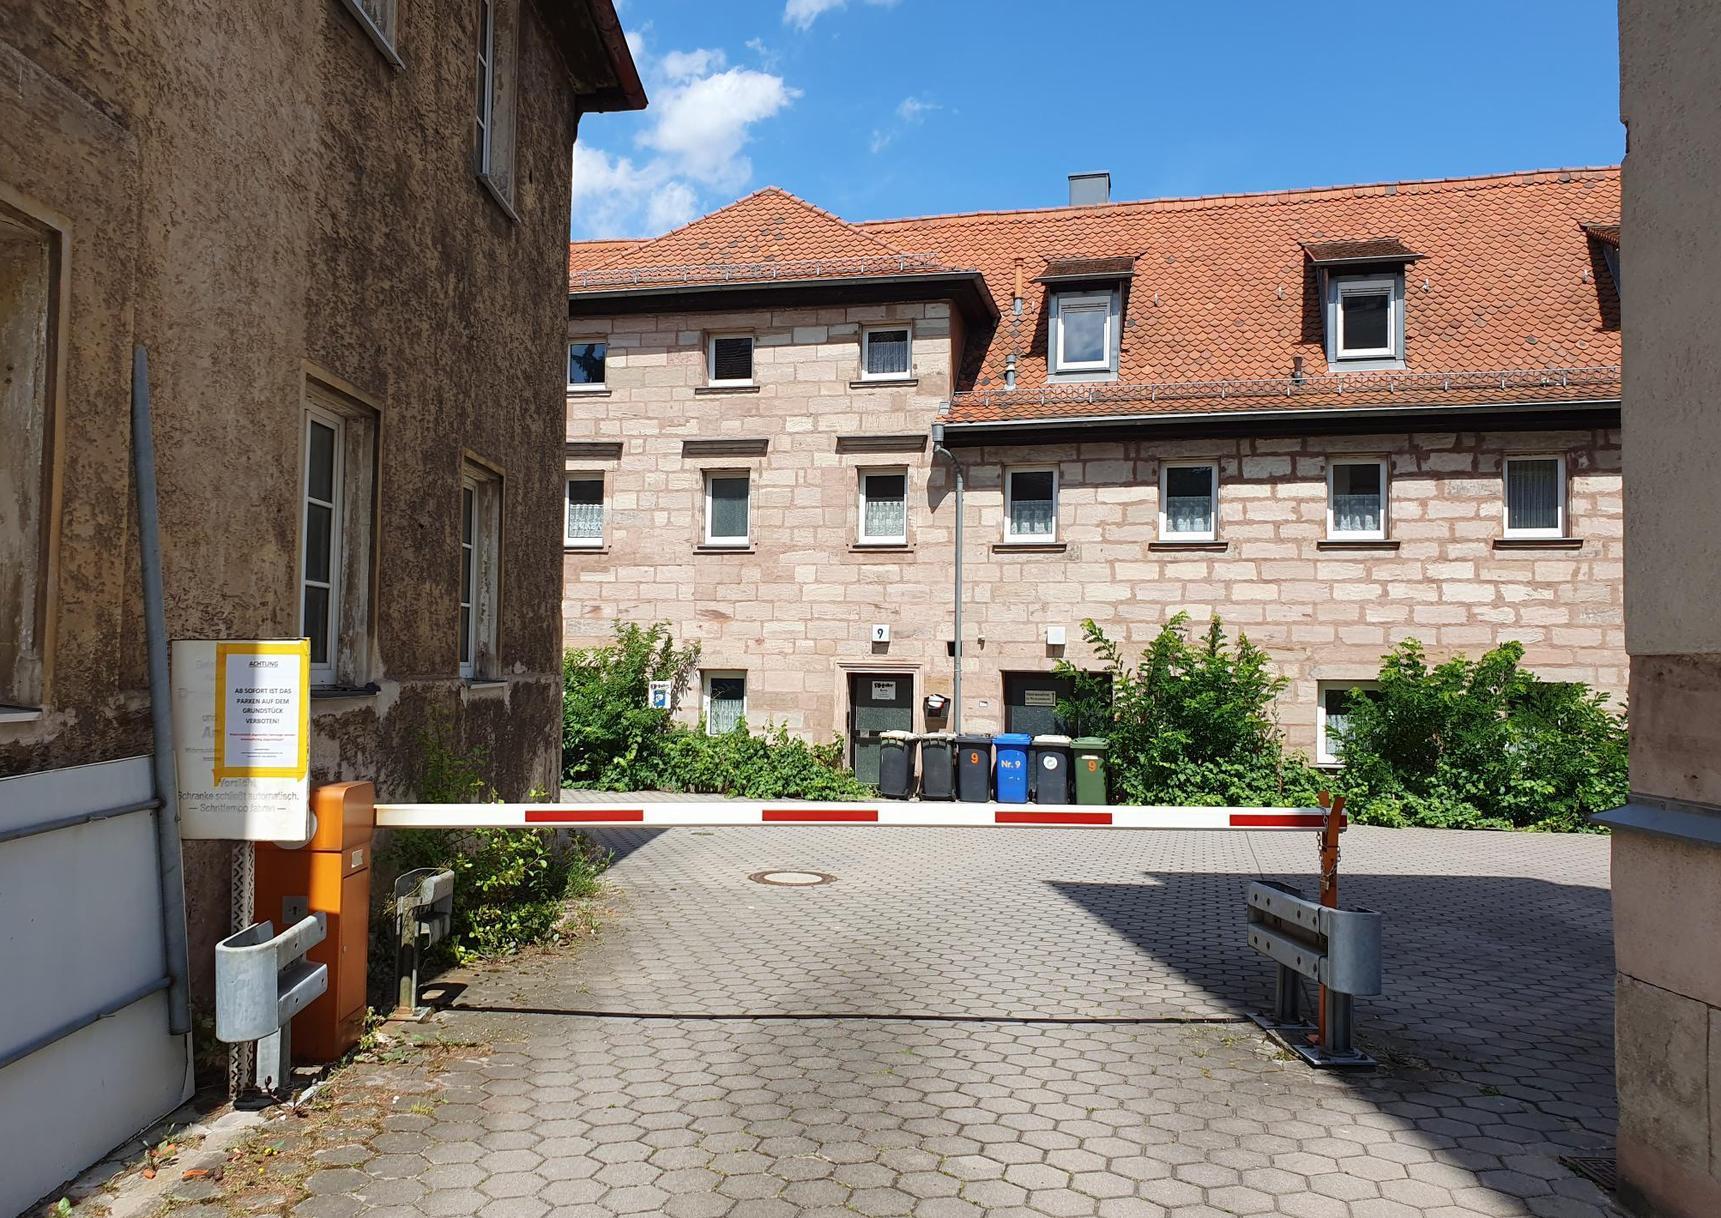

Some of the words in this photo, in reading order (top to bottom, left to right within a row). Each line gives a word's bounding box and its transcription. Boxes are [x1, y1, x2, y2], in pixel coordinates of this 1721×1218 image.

[877, 628, 884, 639] 9
[249, 660, 279, 668] ACHTUNG
[242, 706, 283, 714] GRUNDSTÜCK
[970, 752, 979, 765] 9
[1000, 760, 1014, 769] Nr.
[1014, 760, 1021, 768] 9
[1088, 760, 1097, 772] 9
[178, 791, 214, 801] Schranke
